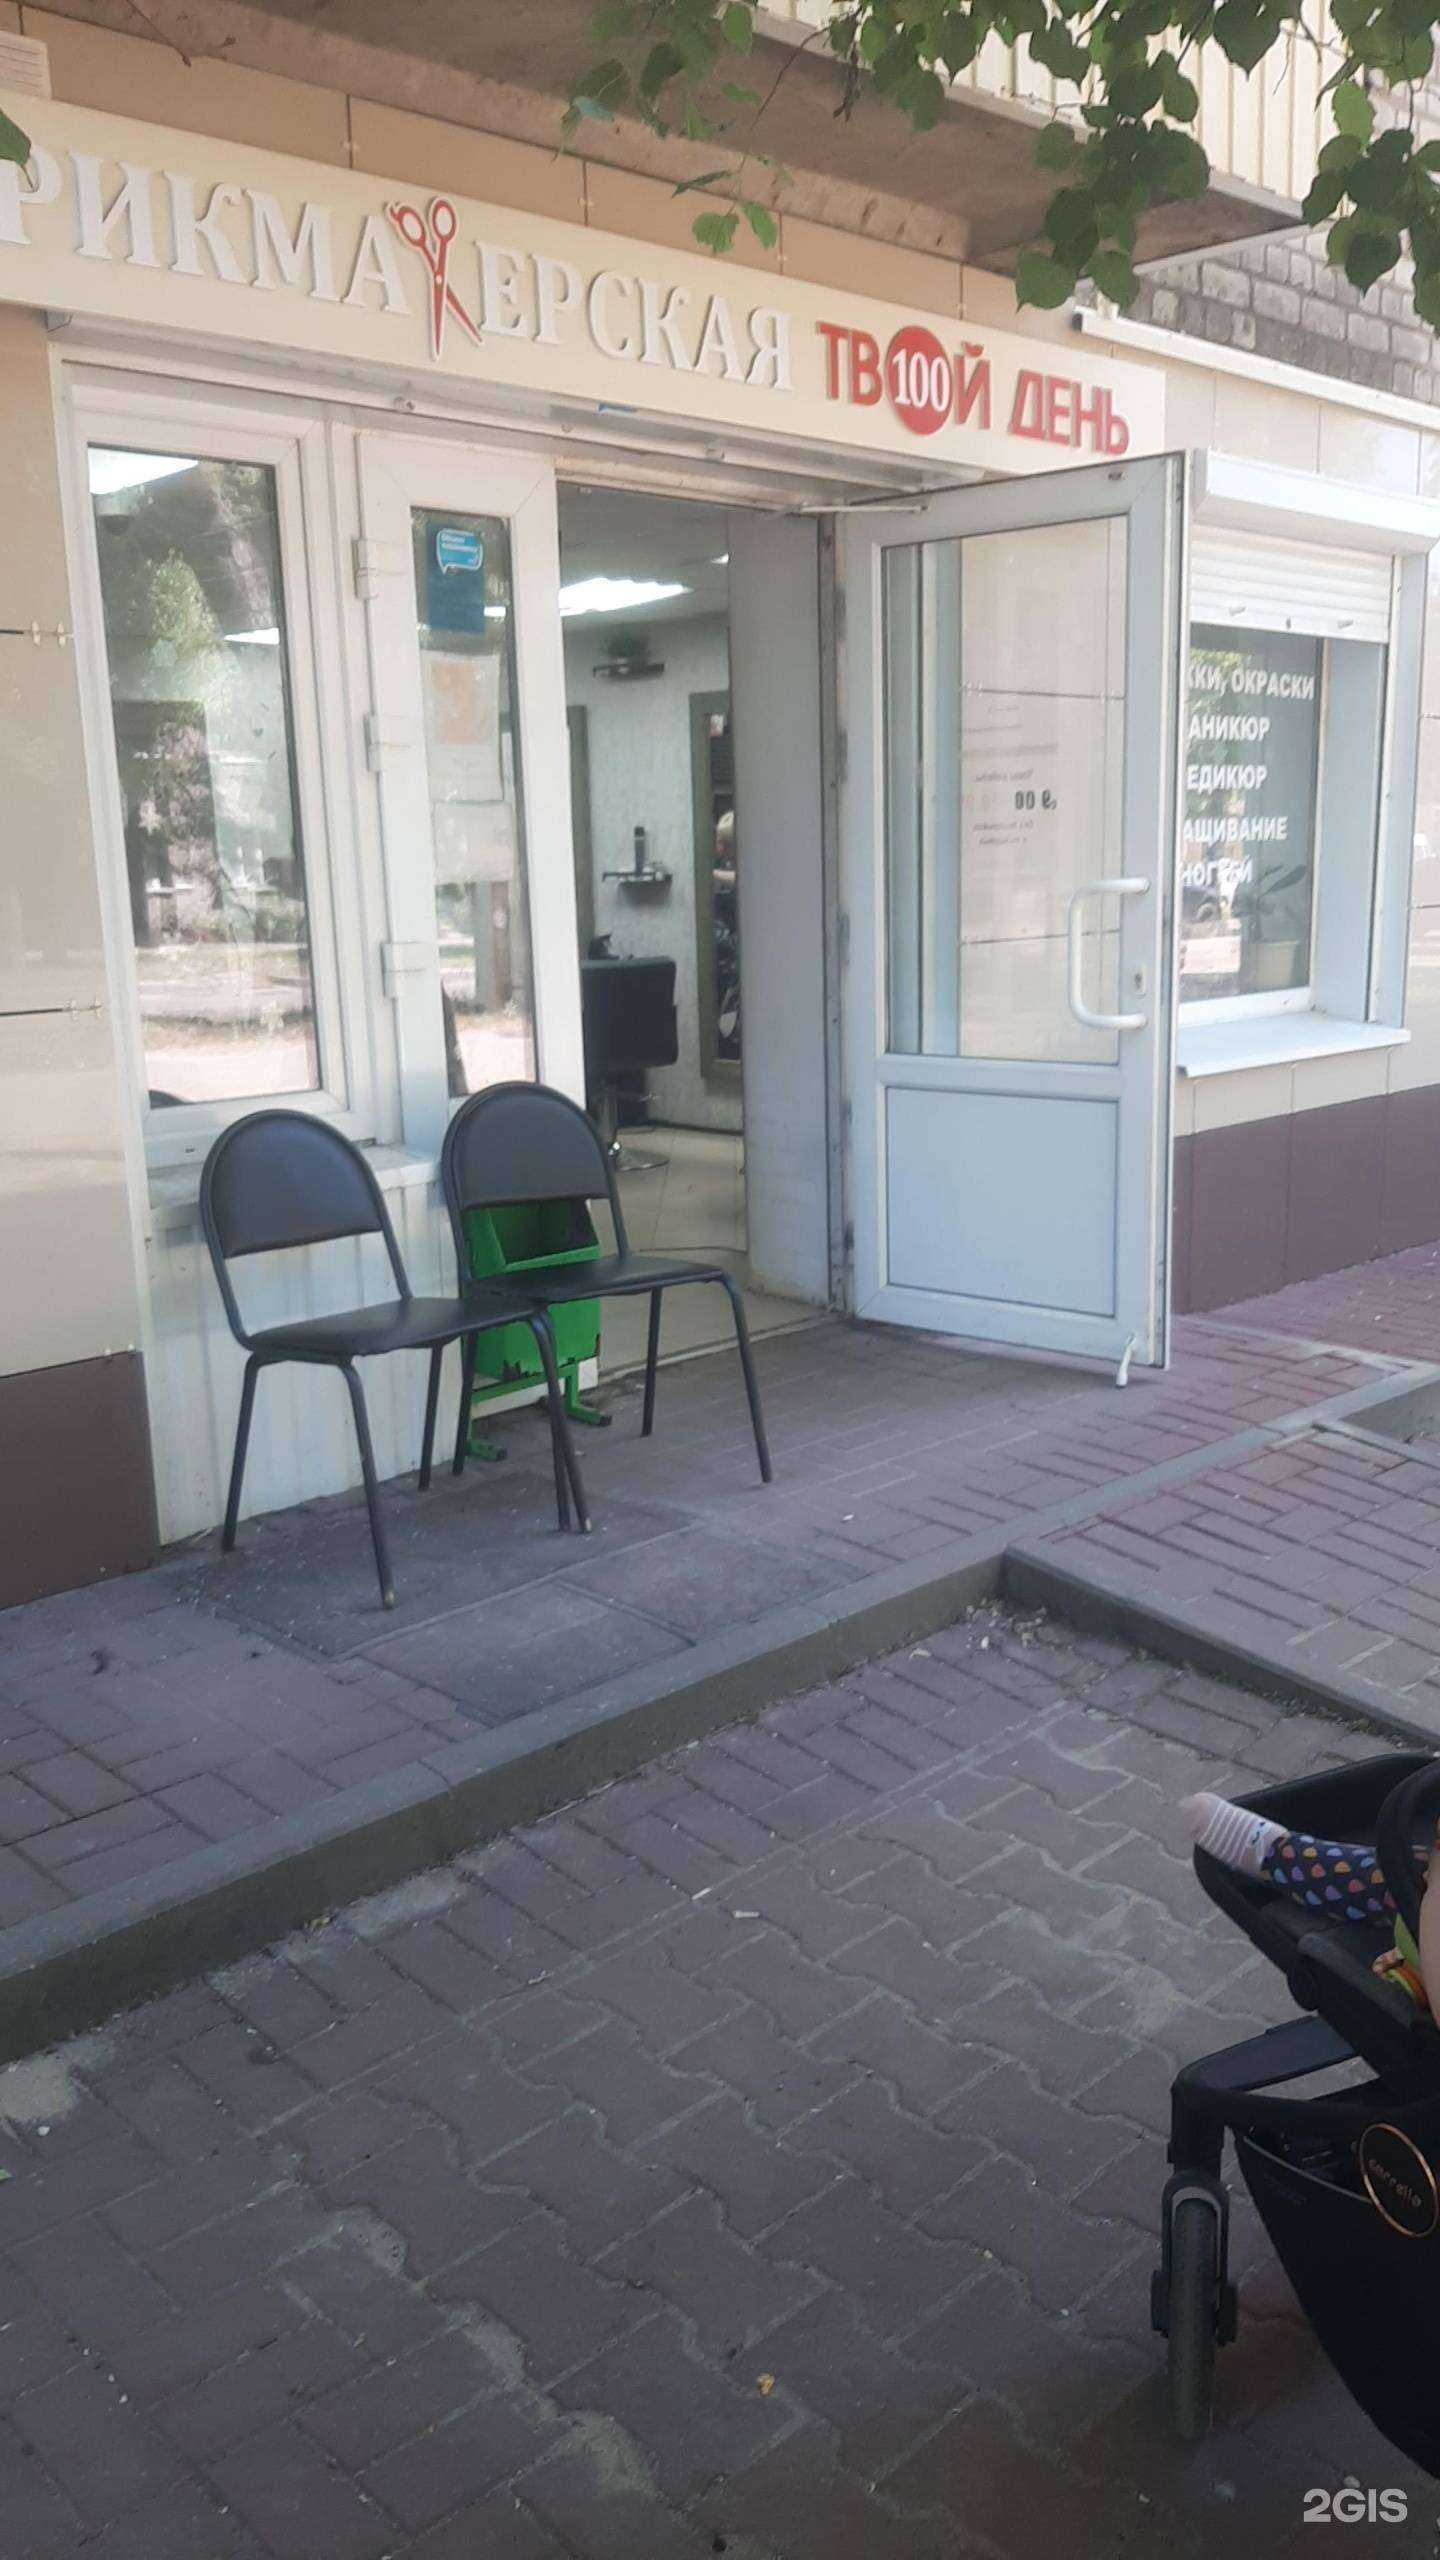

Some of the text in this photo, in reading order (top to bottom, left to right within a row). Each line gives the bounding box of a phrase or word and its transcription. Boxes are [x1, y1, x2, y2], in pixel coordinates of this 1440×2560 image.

[890, 348, 948, 413] 100
[1006, 367, 1129, 455] ДЕНЬ
[1231, 668, 1315, 700] ОКРАСКИ
